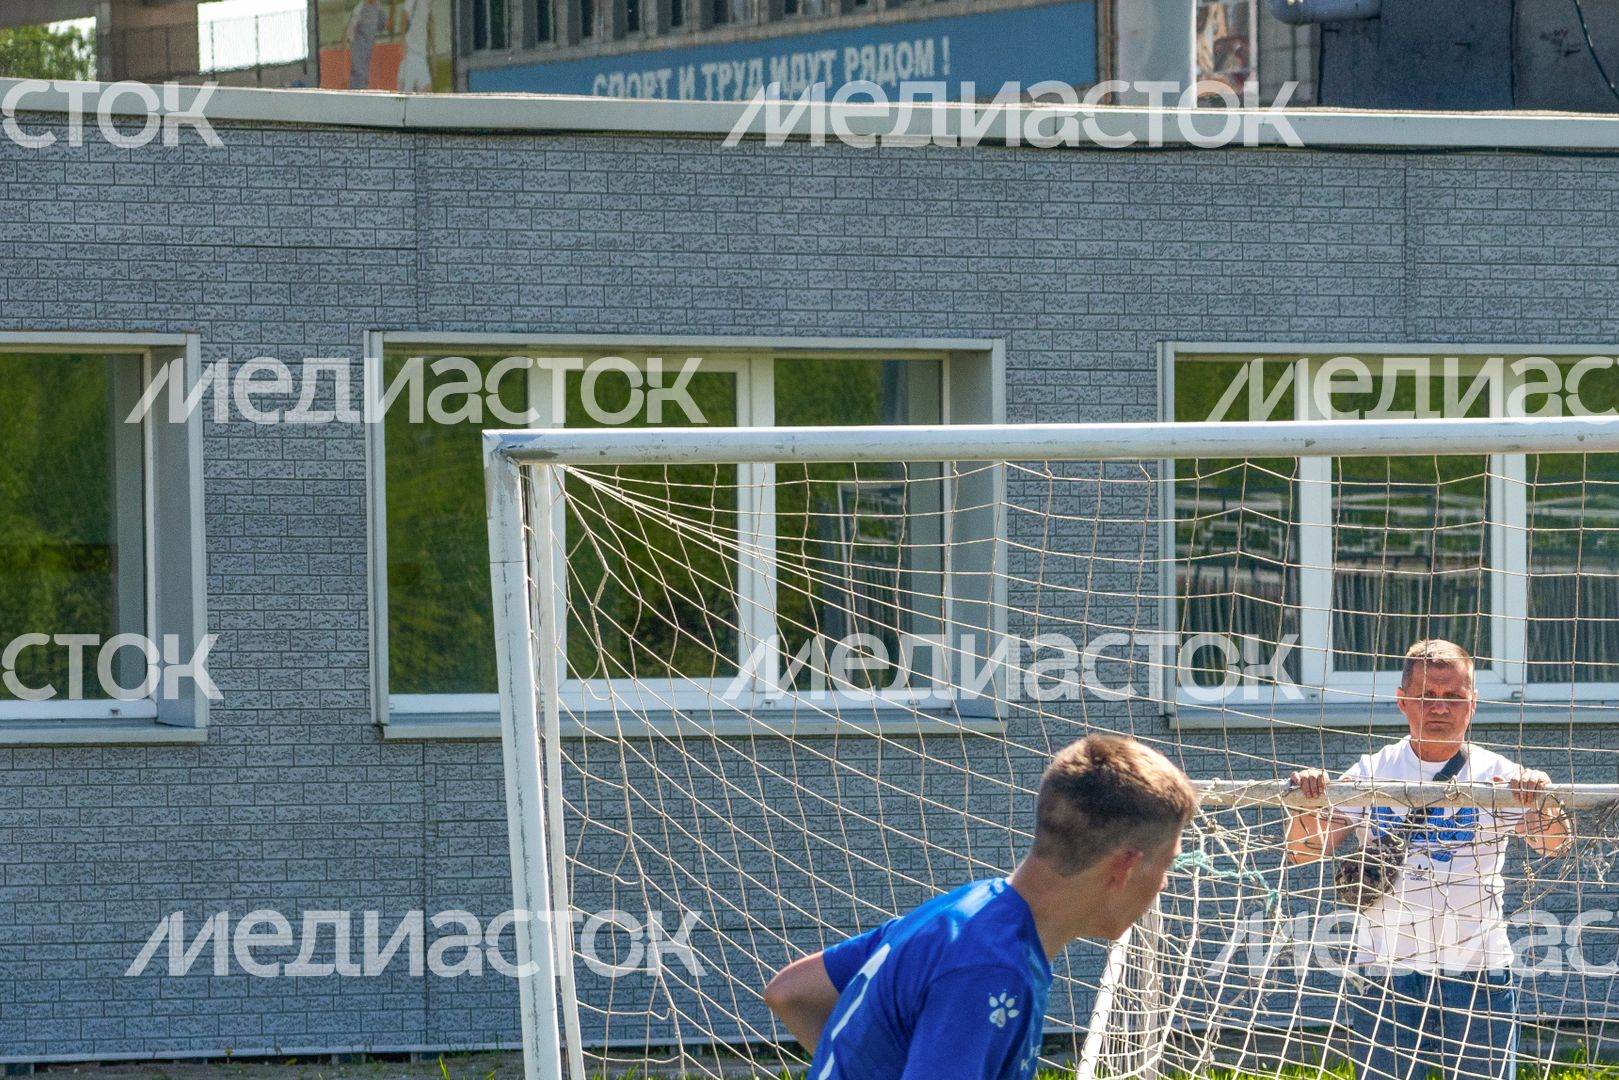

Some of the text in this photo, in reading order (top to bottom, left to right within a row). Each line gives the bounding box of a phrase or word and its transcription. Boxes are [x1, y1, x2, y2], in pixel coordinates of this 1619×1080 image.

[592, 68, 673, 98] СПОРТ
[678, 64, 697, 99] И
[701, 57, 765, 99] ТРУД
[769, 49, 837, 98] ИДУТ
[844, 37, 935, 87] РЯДОМ
